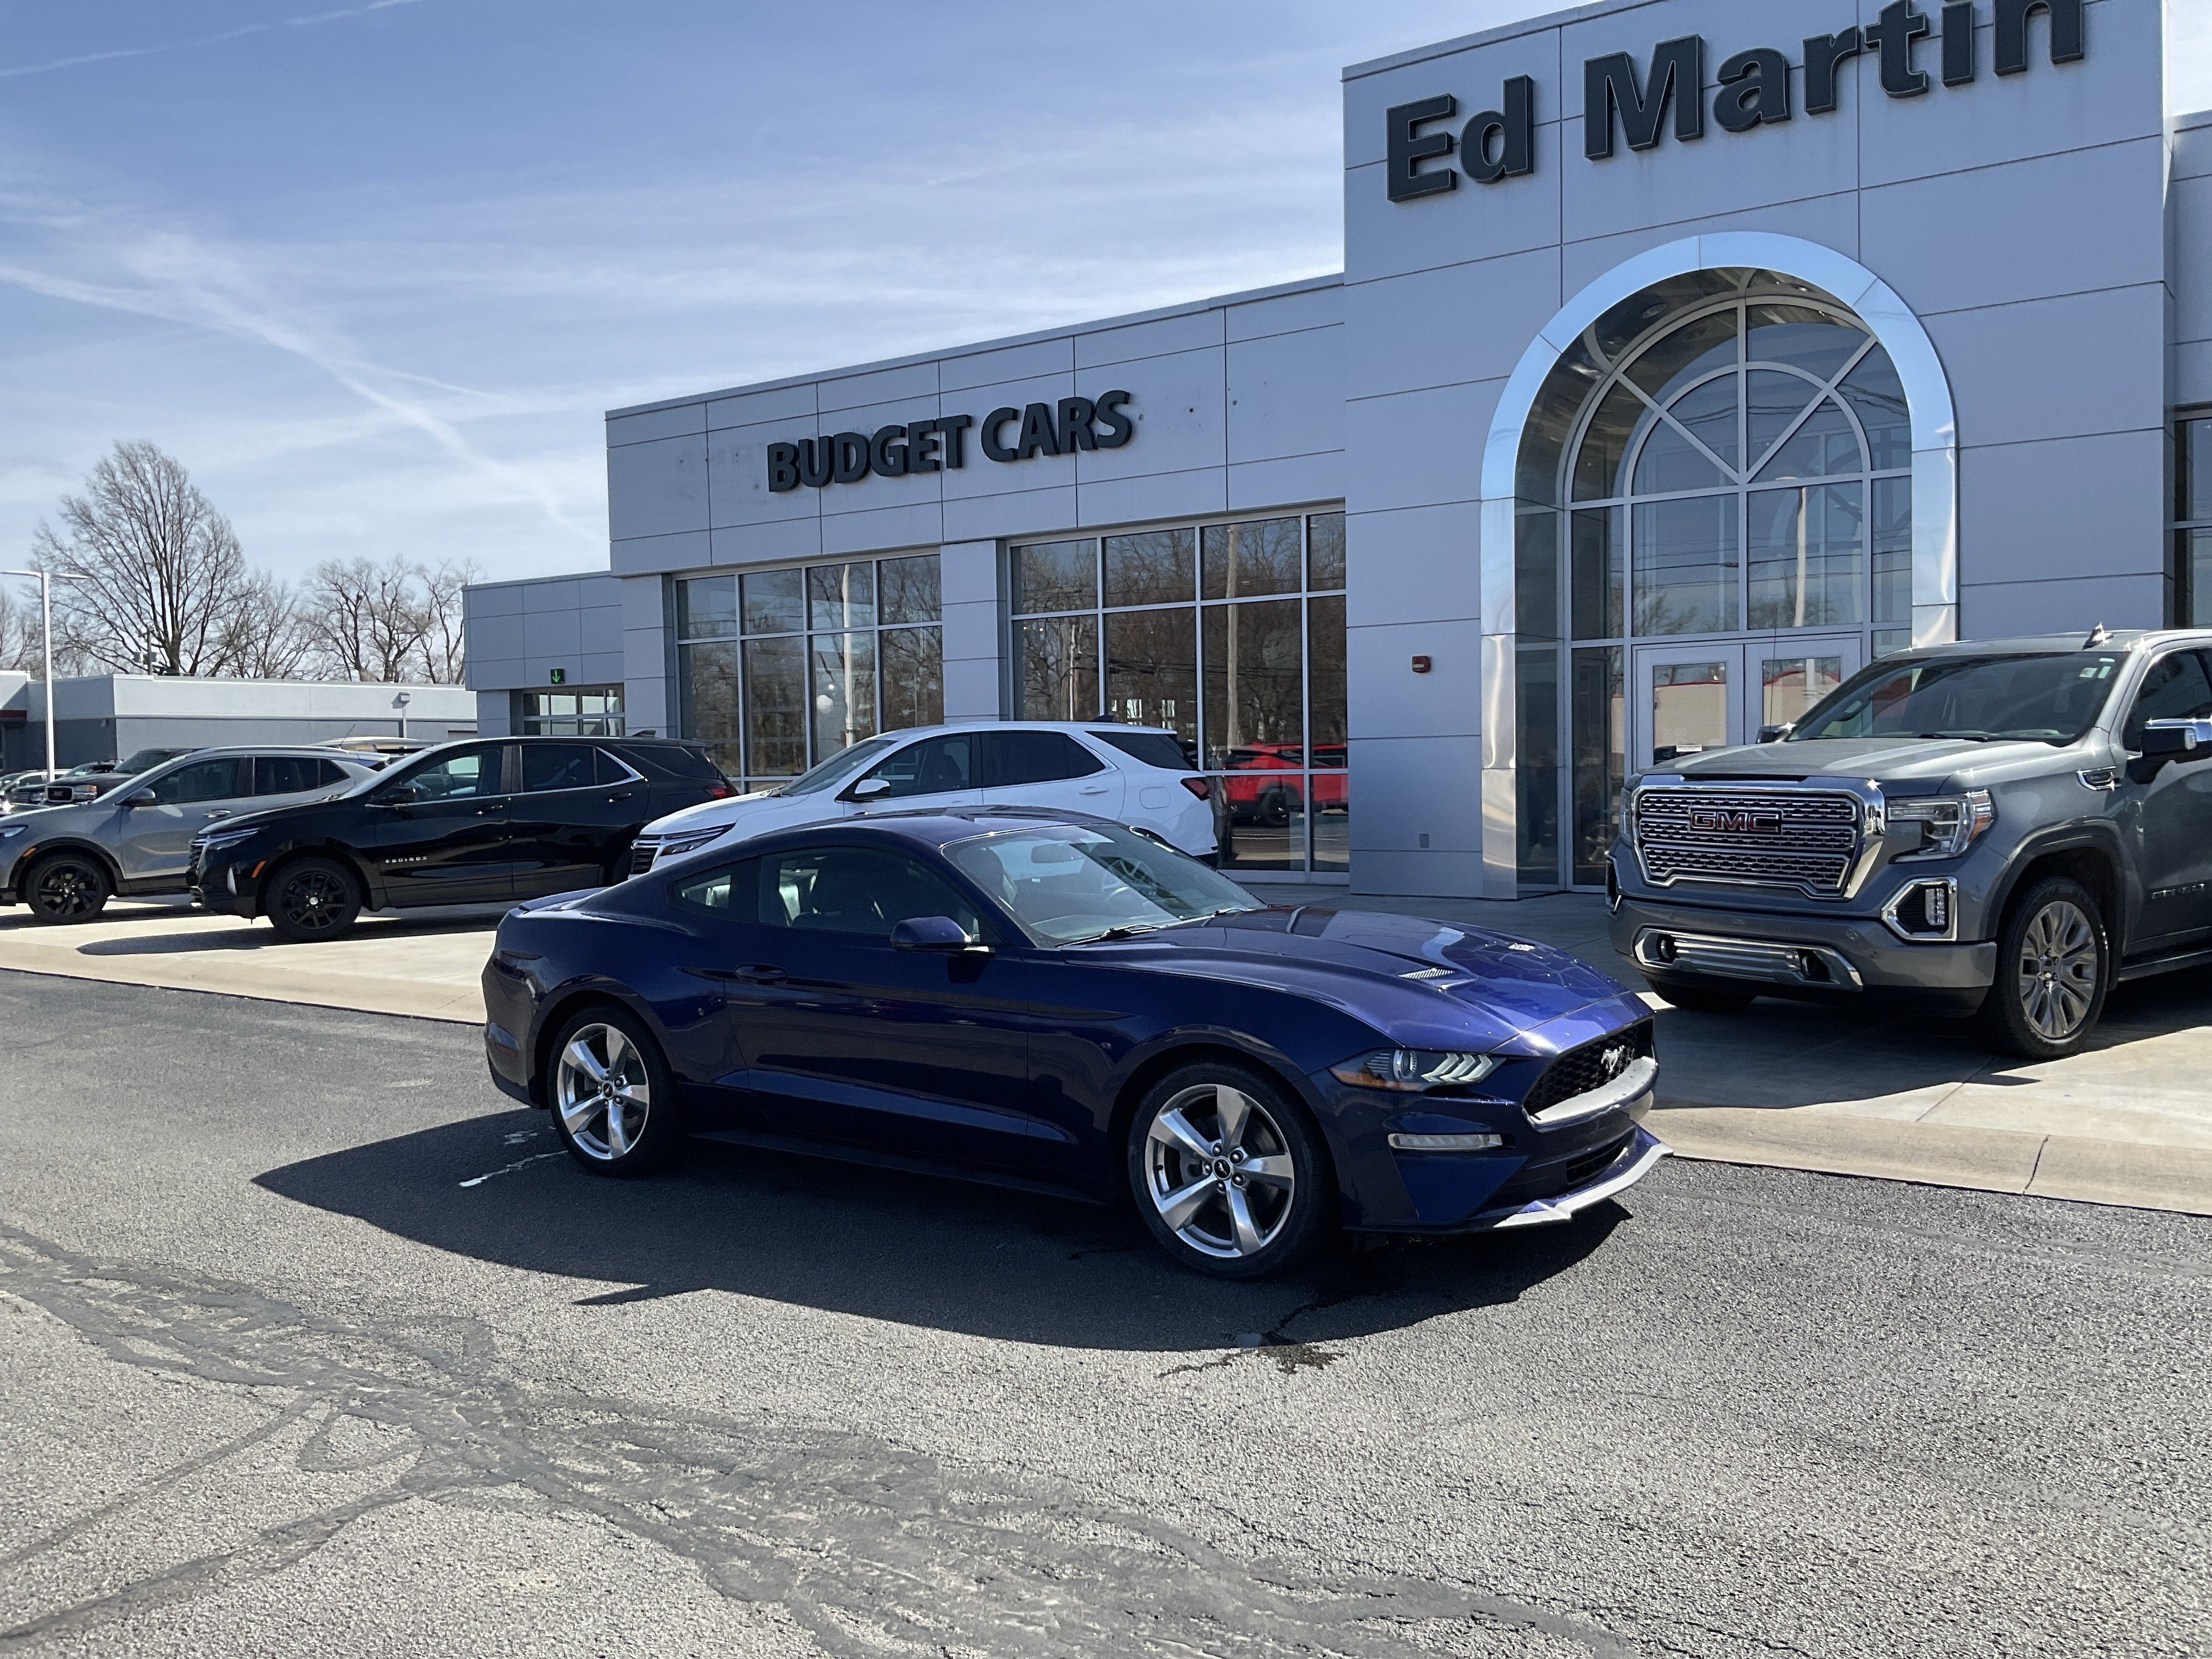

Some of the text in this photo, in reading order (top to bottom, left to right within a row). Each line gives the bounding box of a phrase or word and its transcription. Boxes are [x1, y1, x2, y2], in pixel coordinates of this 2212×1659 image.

[1387, 0, 2083, 202] Ed Martin
[768, 390, 1132, 493] BUDGET CARS
[1690, 811, 1779, 833] GMC
